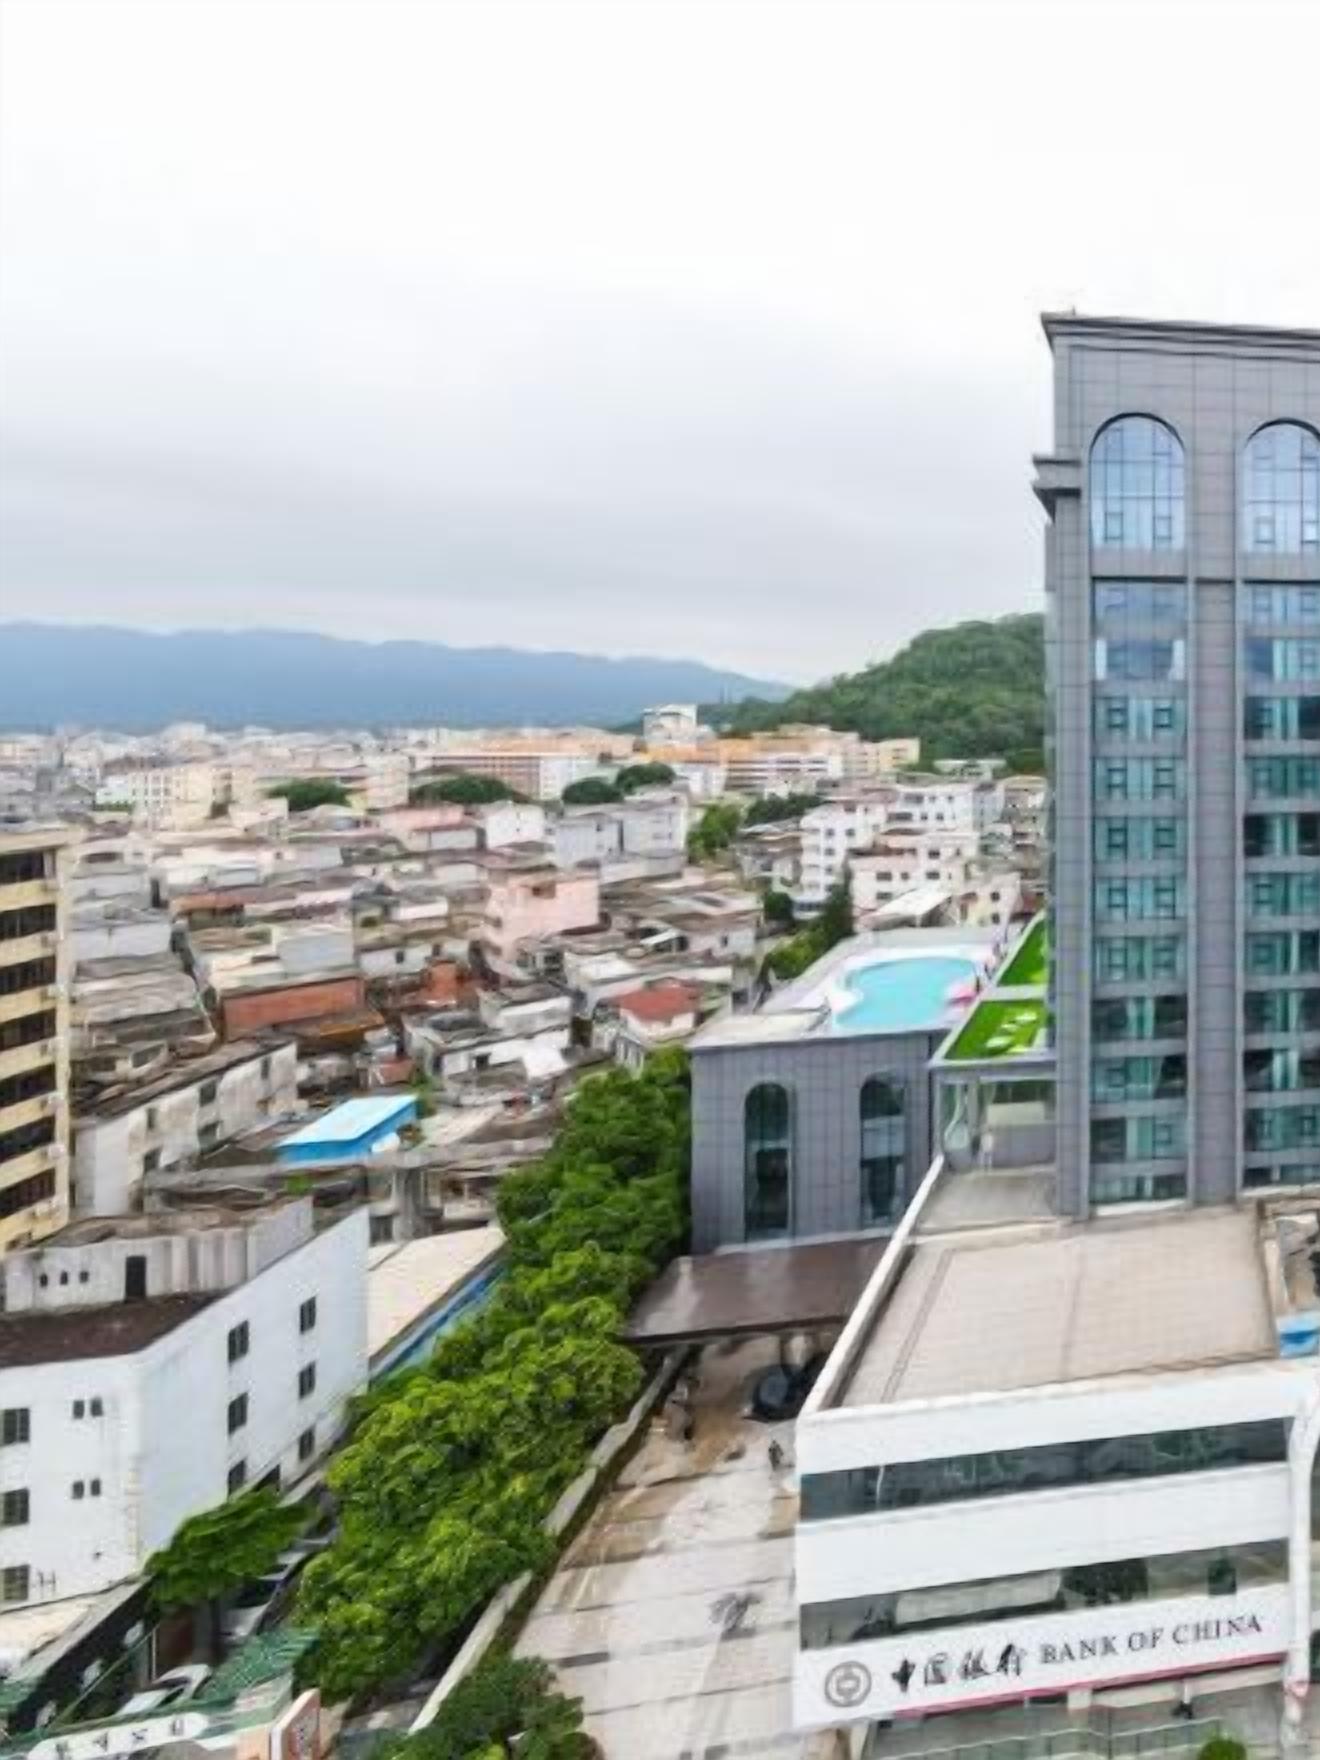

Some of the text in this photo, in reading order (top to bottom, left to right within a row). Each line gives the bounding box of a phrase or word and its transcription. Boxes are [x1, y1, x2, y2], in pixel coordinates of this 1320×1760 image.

[1040, 1614, 1263, 1664] BANK OF CHINA
